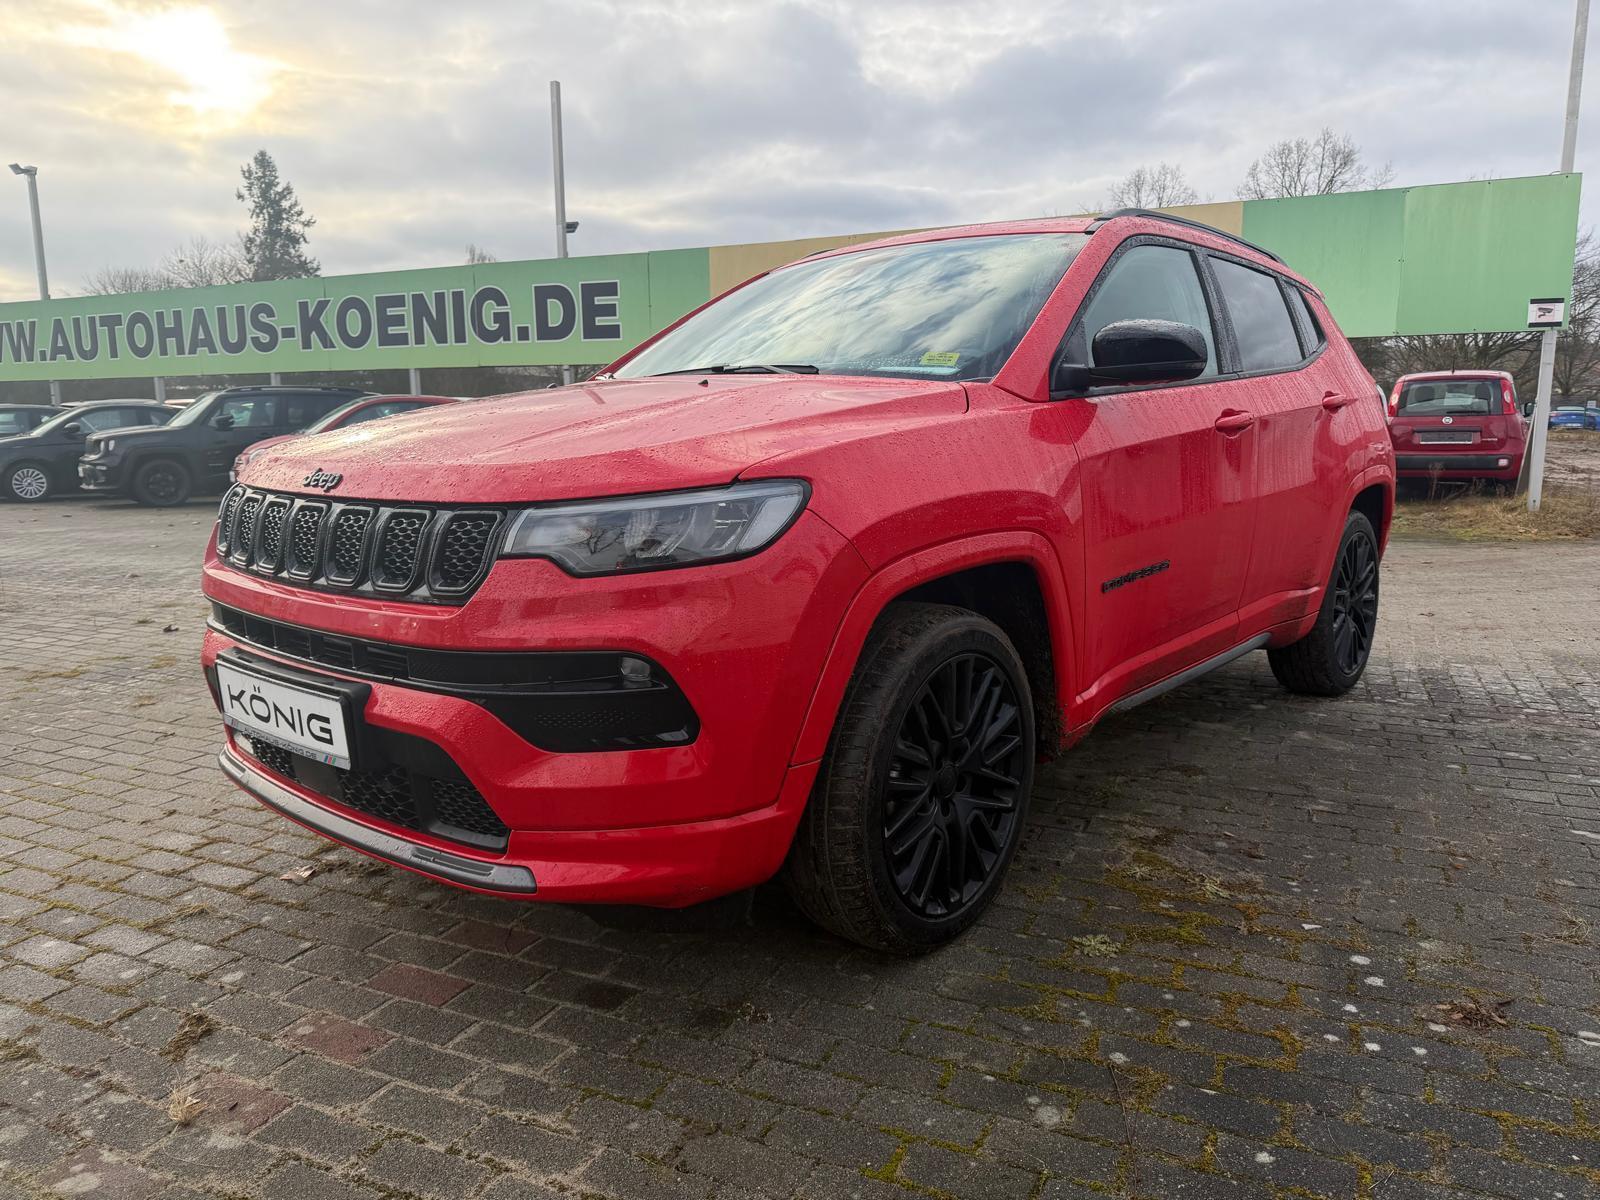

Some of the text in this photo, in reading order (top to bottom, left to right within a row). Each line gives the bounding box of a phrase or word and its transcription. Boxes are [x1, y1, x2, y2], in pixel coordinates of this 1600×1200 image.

[0, 280, 622, 363] W.AUTOHAUS-KOENIG.DE
[303, 467, 343, 493] Jeep
[227, 684, 334, 746] KÖNIG
